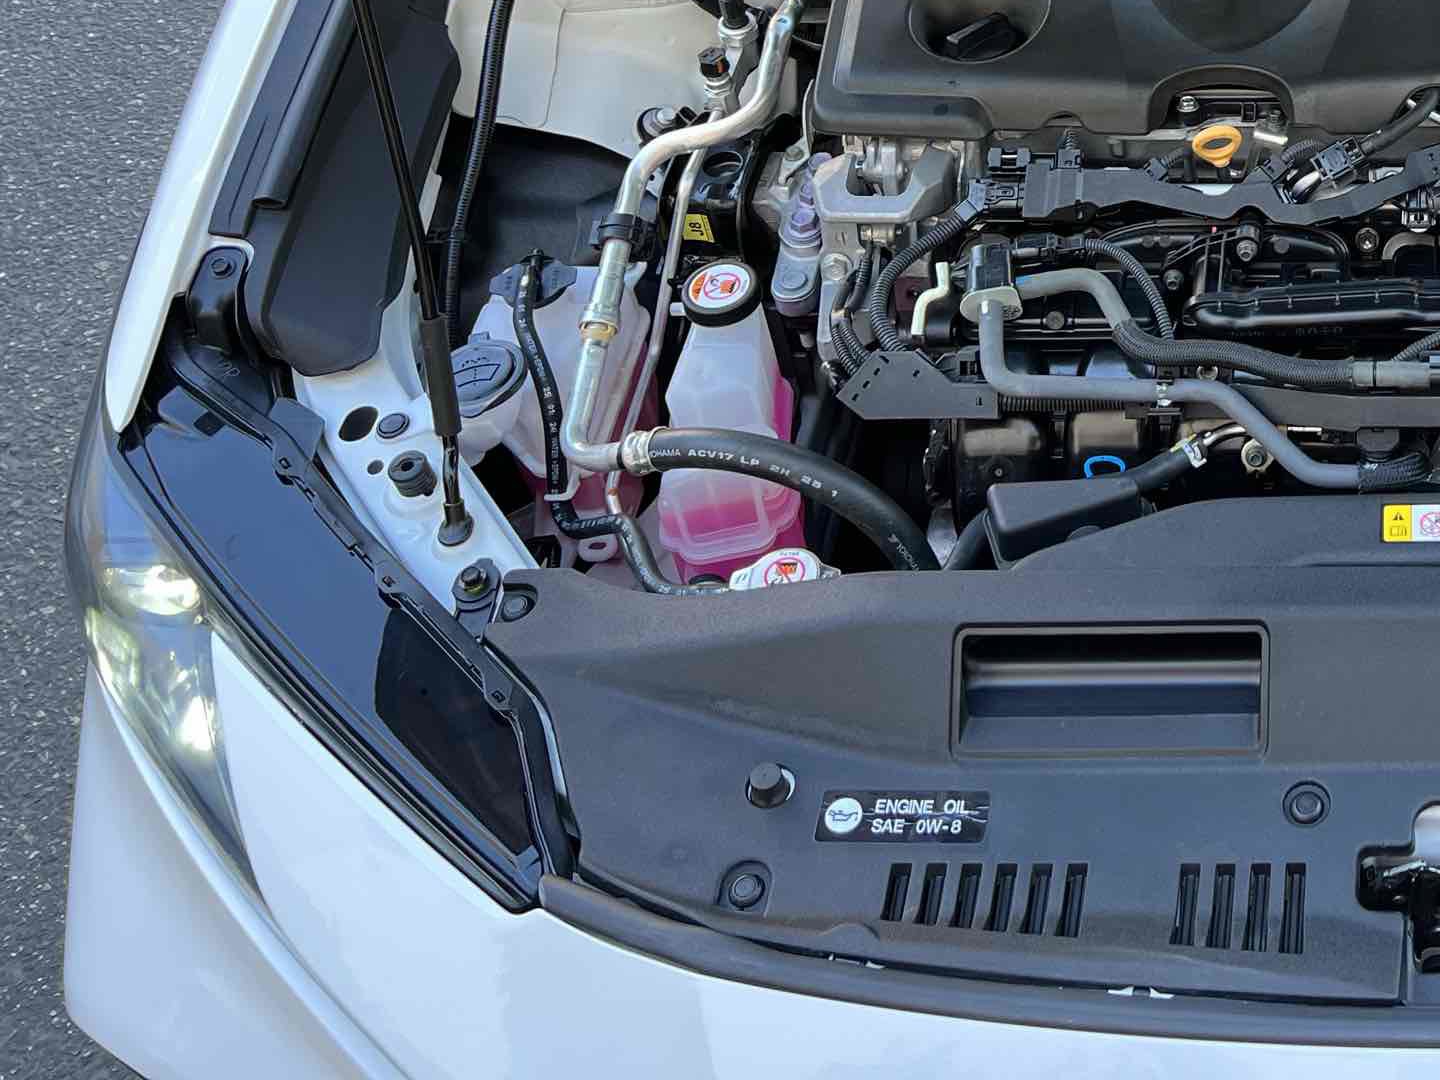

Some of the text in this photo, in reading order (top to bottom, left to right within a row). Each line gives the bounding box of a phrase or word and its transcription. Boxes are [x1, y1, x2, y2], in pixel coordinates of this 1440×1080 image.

[687, 448, 735, 461] ACV17
[875, 799, 970, 814] ENGINE OIL
[871, 818, 962, 834] SAE 0W-8
